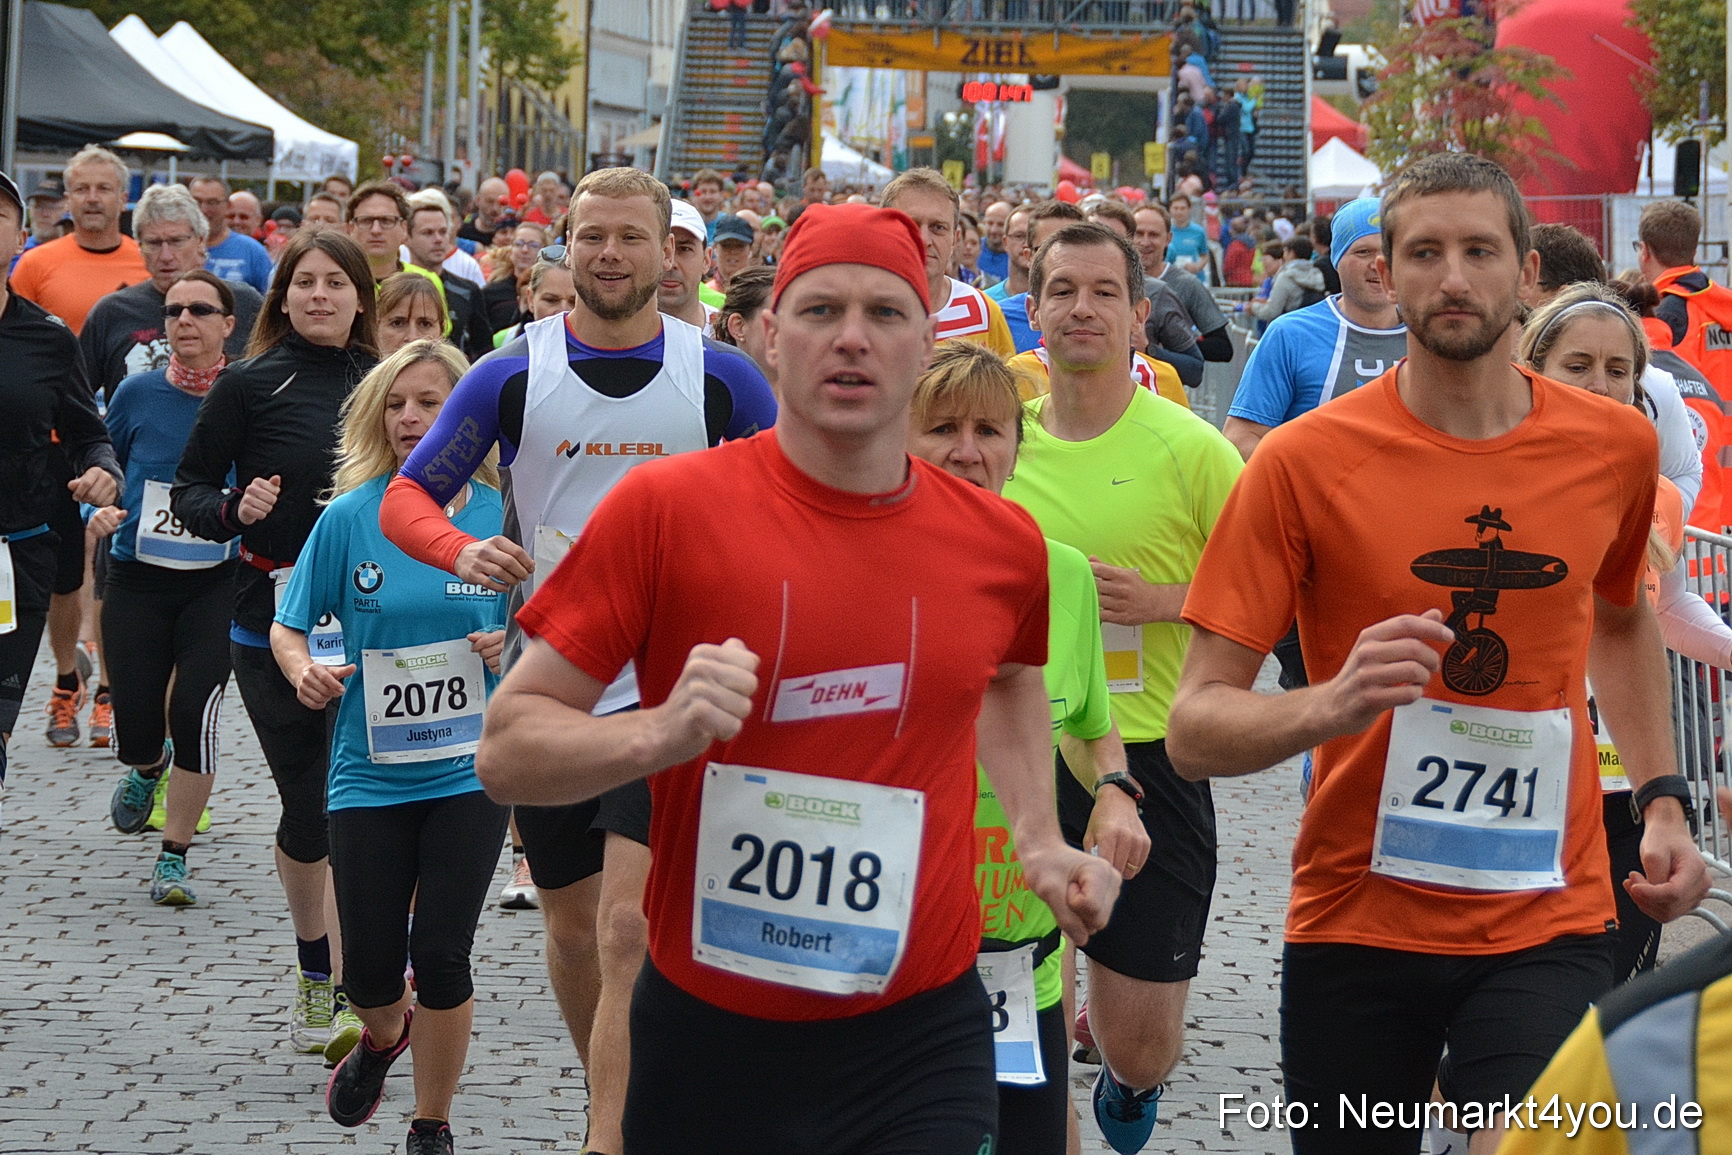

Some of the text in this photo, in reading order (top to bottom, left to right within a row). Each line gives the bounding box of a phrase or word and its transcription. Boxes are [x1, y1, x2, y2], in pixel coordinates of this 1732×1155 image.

[960, 38, 1036, 67] ZIEL
[420, 415, 485, 492] STEP
[585, 442, 671, 457] KLEBL
[152, 508, 197, 539] 29
[356, 561, 382, 575] BMW
[353, 598, 382, 608] PARTL
[354, 606, 382, 614] Neumarkt
[406, 653, 449, 668] BOCK
[383, 676, 468, 719] 2078
[810, 681, 868, 705] DEHN
[406, 726, 452, 743] Justyna
[1469, 722, 1534, 745] BOCK
[1598, 751, 1622, 766] Ma
[1411, 755, 1539, 818] 2741
[786, 794, 862, 821] BOCK
[727, 832, 882, 912] 2018
[707, 878, 715, 890] D
[760, 921, 833, 954] Robert
